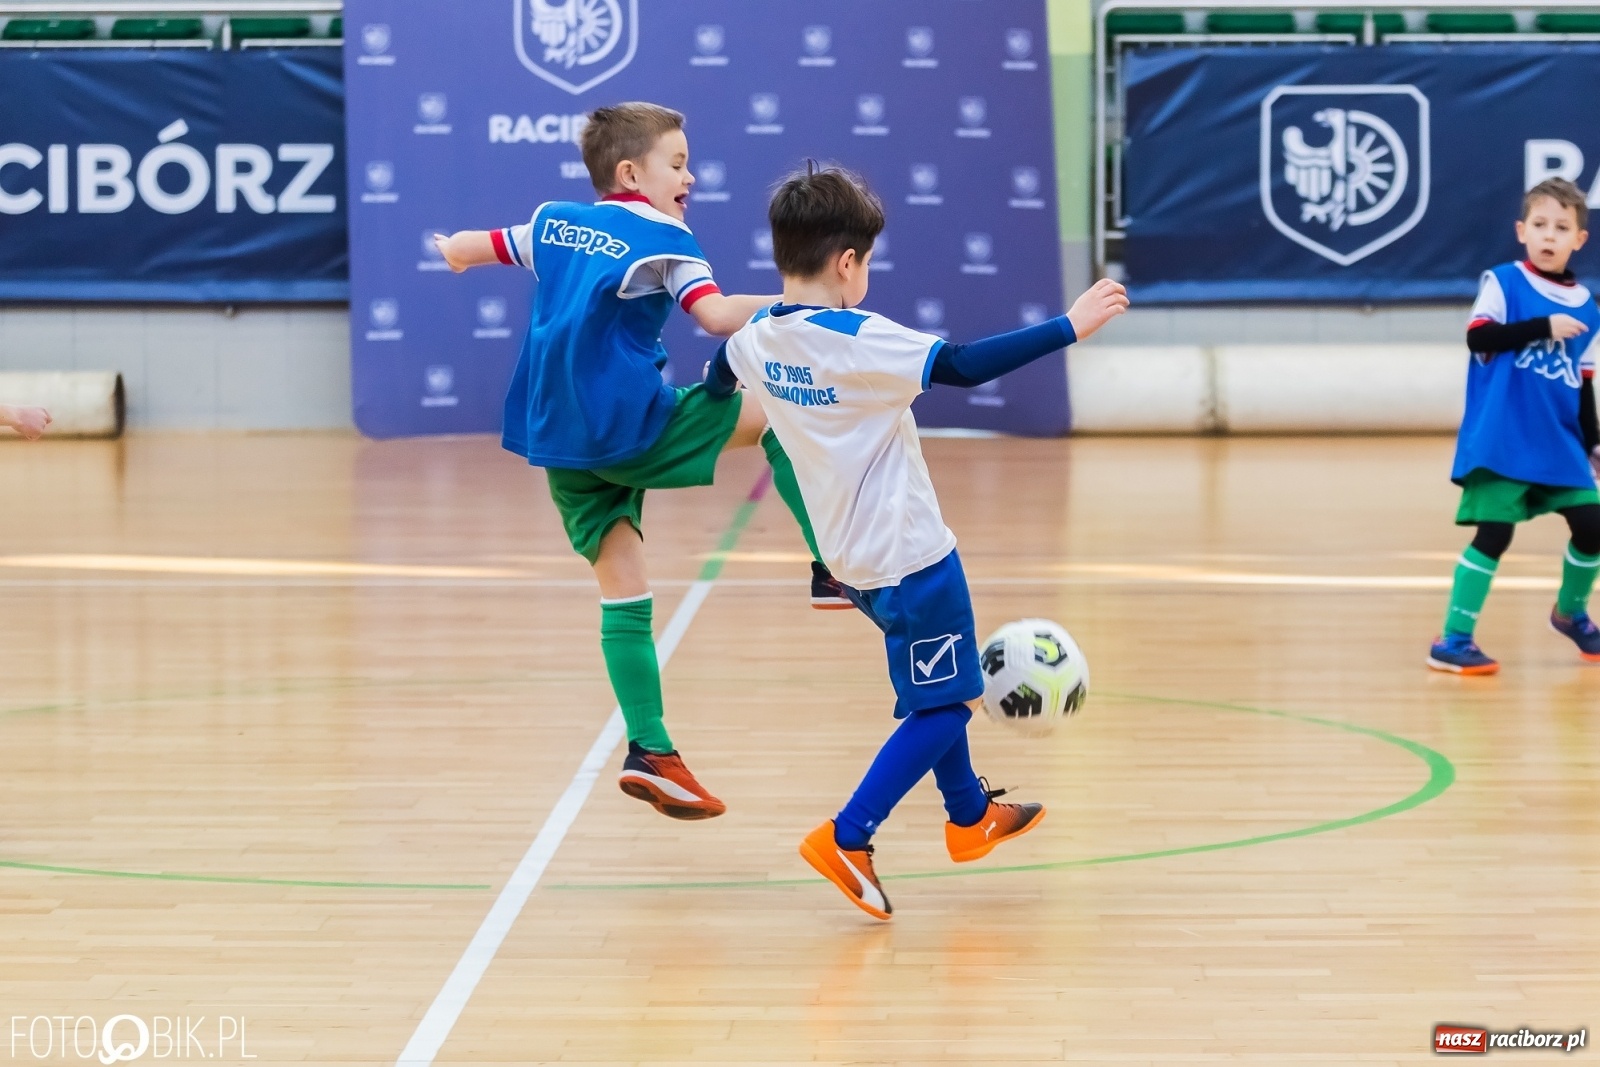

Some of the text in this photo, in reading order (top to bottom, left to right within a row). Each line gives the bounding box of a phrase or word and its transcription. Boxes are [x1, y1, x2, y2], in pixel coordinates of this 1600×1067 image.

[541, 219, 630, 259] Kappa
[765, 361, 814, 385] KS 1905
